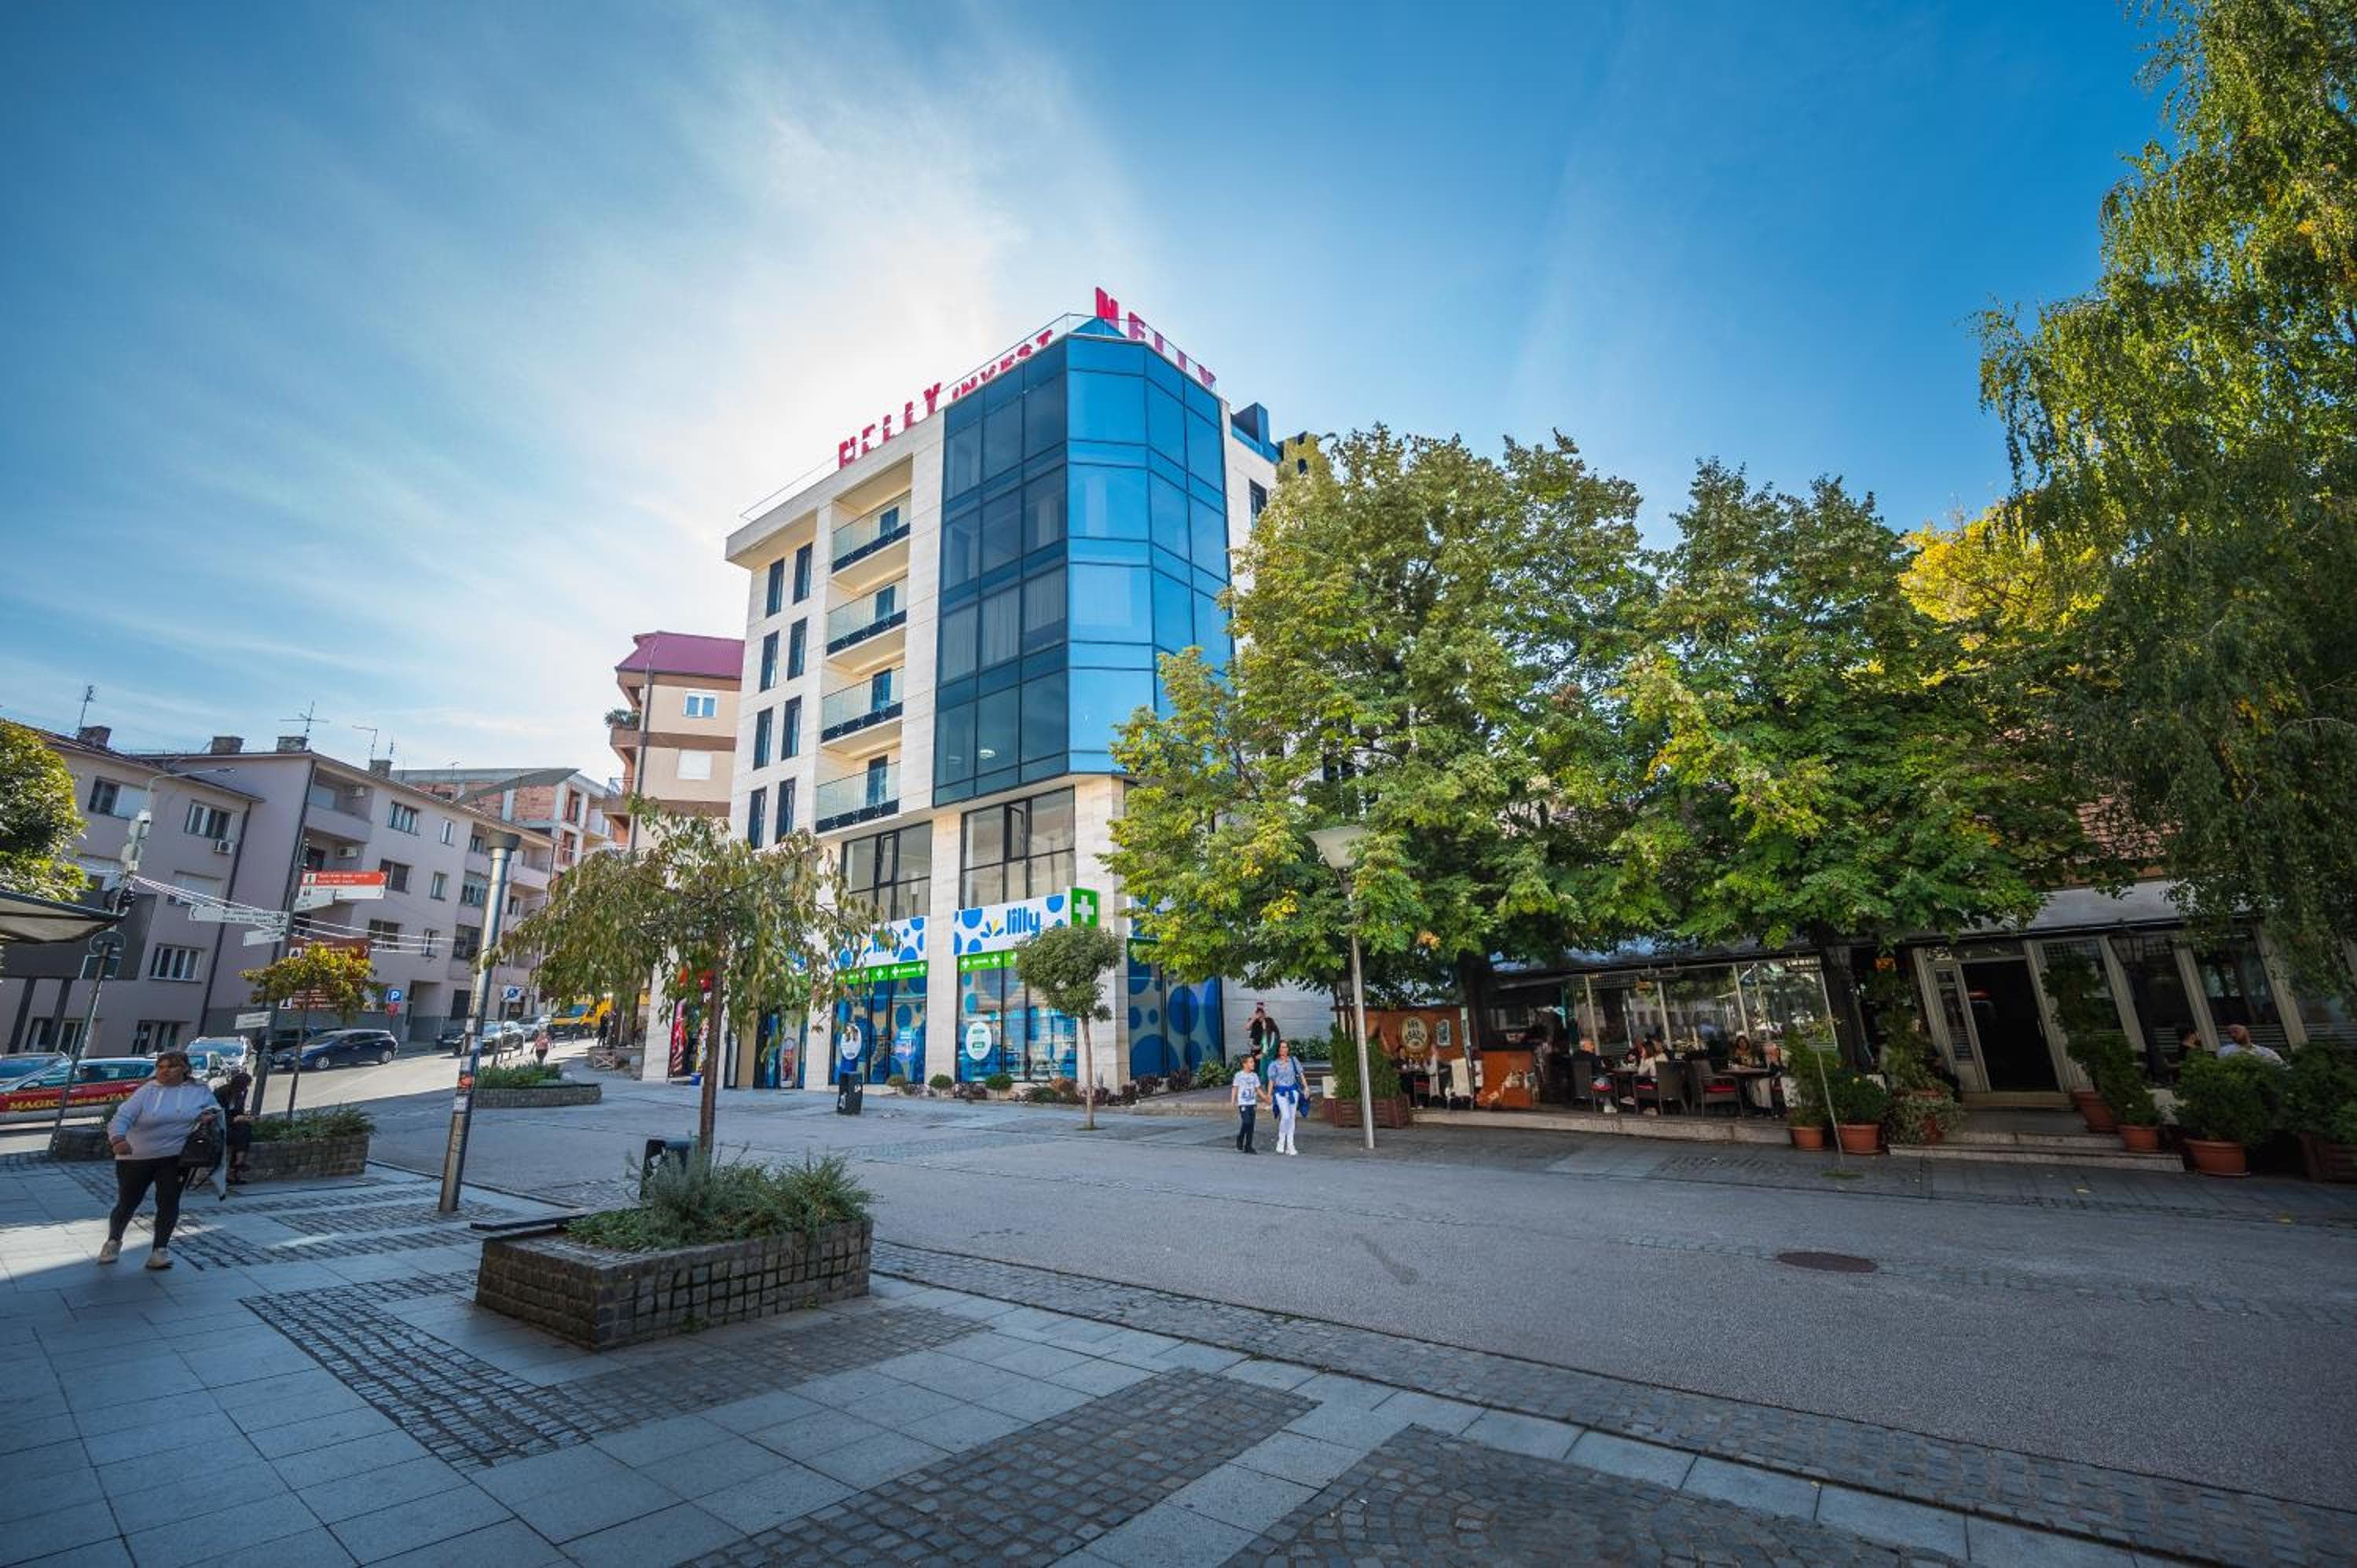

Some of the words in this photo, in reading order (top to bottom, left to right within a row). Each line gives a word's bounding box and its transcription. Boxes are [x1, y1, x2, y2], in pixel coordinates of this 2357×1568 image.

[838, 383, 941, 471] NELLY
[951, 329, 1054, 400] INVEST
[1006, 906, 1041, 940] lilly
[9, 1098, 60, 1110] MAGIC
